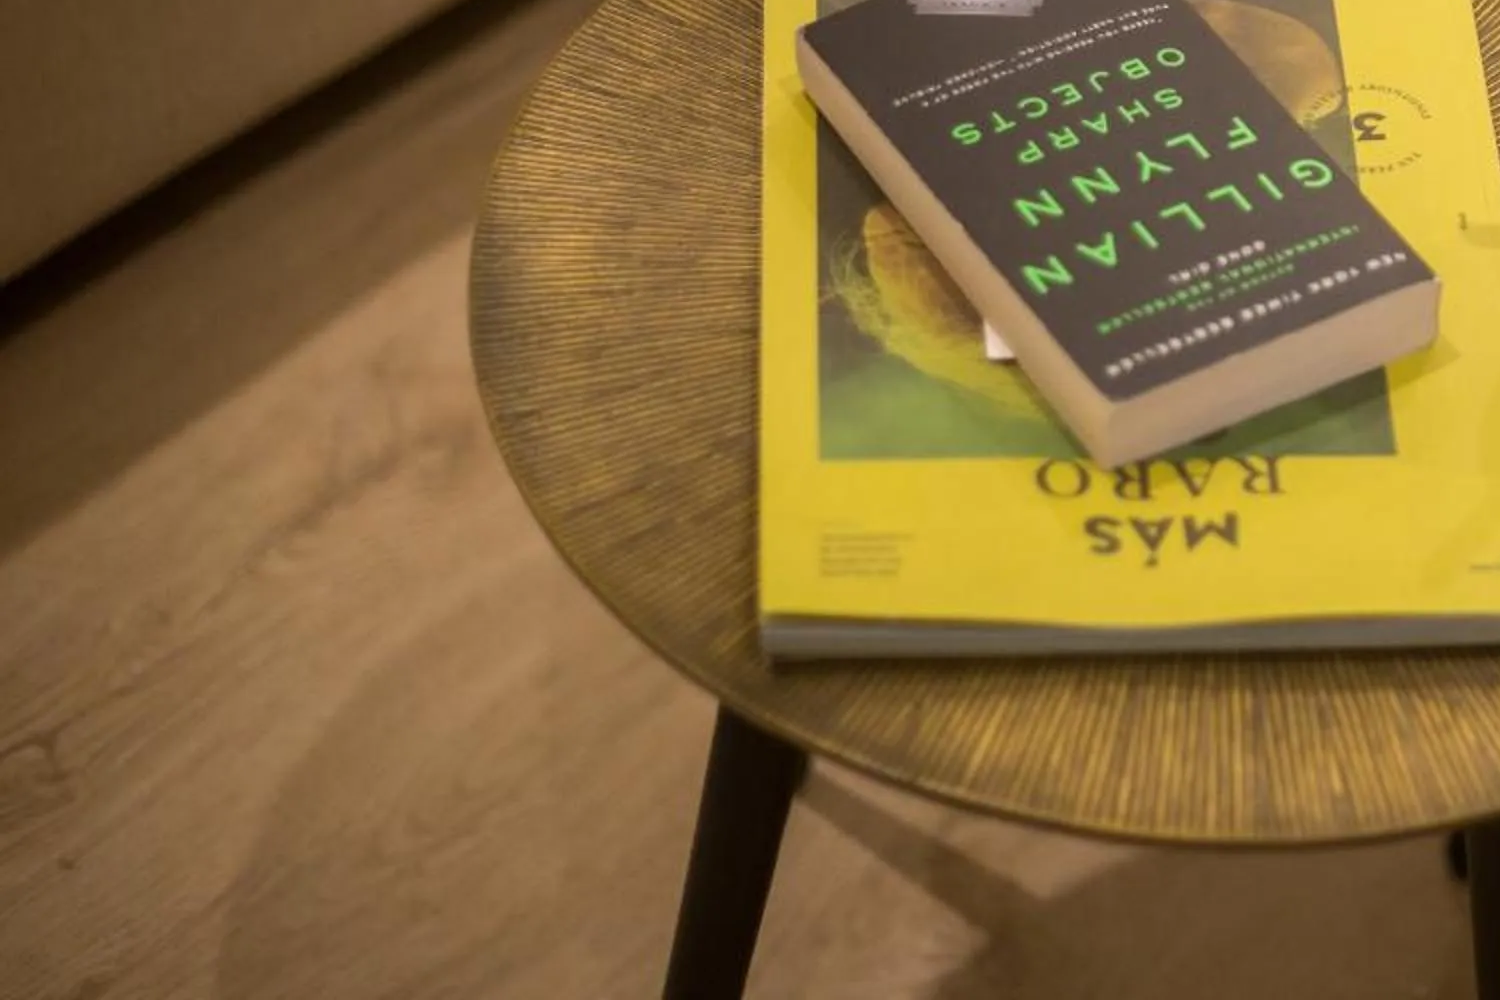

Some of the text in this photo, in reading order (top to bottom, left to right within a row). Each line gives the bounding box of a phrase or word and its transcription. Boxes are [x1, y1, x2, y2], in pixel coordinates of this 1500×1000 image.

[952, 47, 1185, 144] OBJECTS
[1018, 88, 1182, 163] SHARP
[1353, 112, 1387, 142] 3
[1014, 116, 1257, 225] FLYNN
[1023, 158, 1332, 293] GILLIAN
[1034, 454, 1285, 500] RARO
[1084, 511, 1238, 567] MÁS
